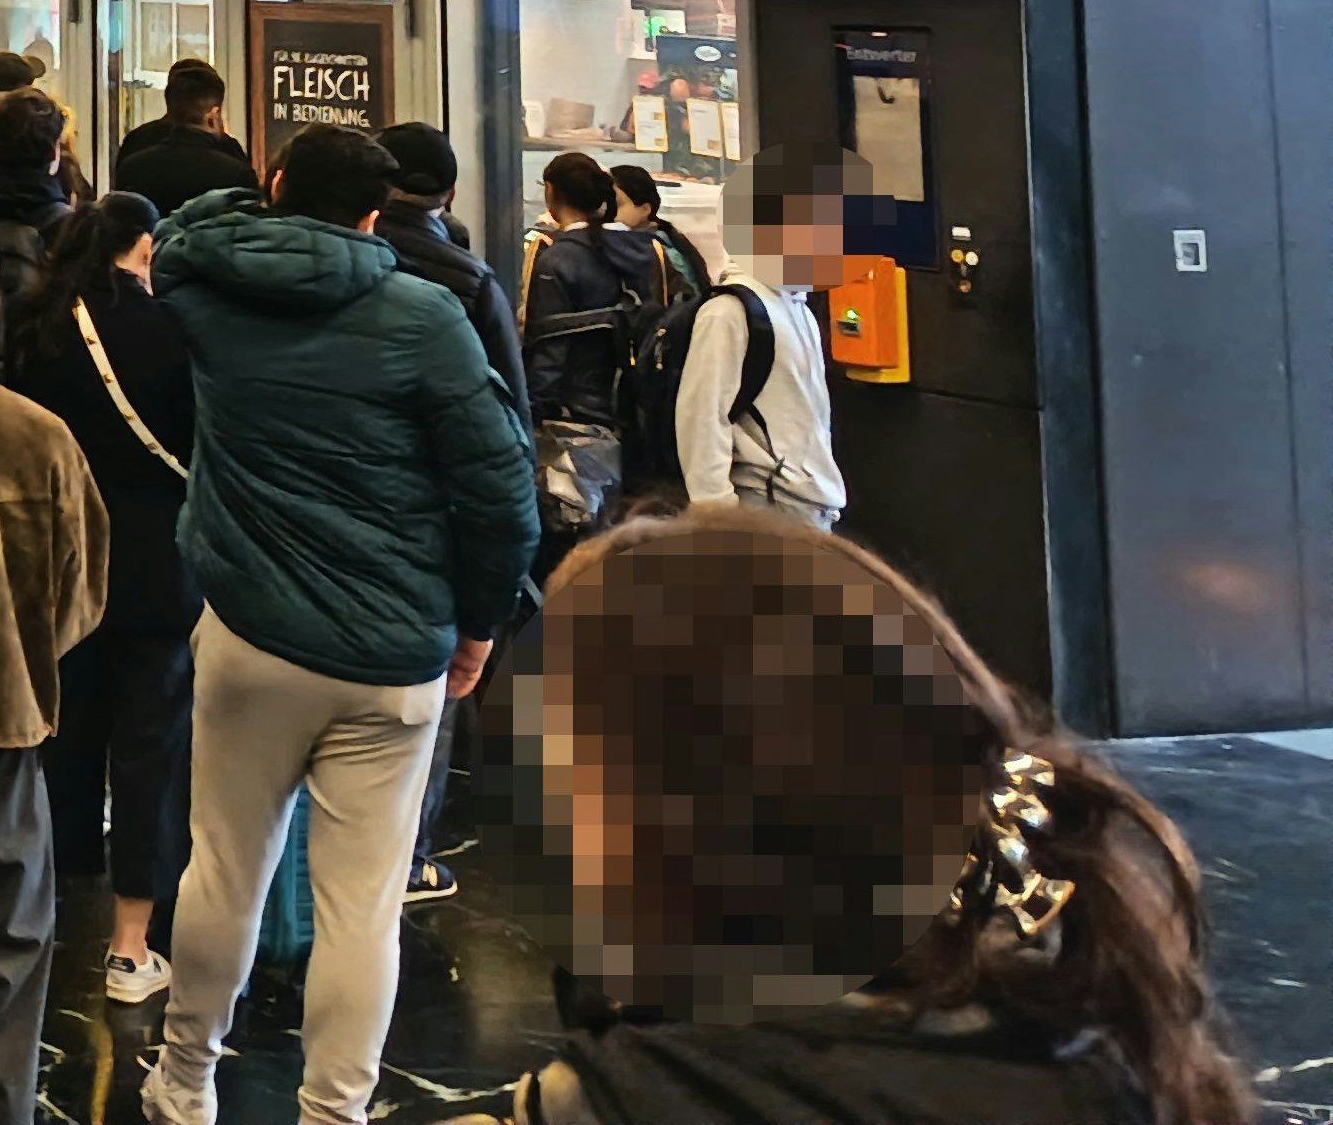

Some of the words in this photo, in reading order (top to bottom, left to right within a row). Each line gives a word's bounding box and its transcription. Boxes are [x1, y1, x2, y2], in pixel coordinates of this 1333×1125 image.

[274, 65, 371, 102] FLEISCH
[274, 102, 288, 121] IN
[292, 103, 371, 128] BEDIENUNG
